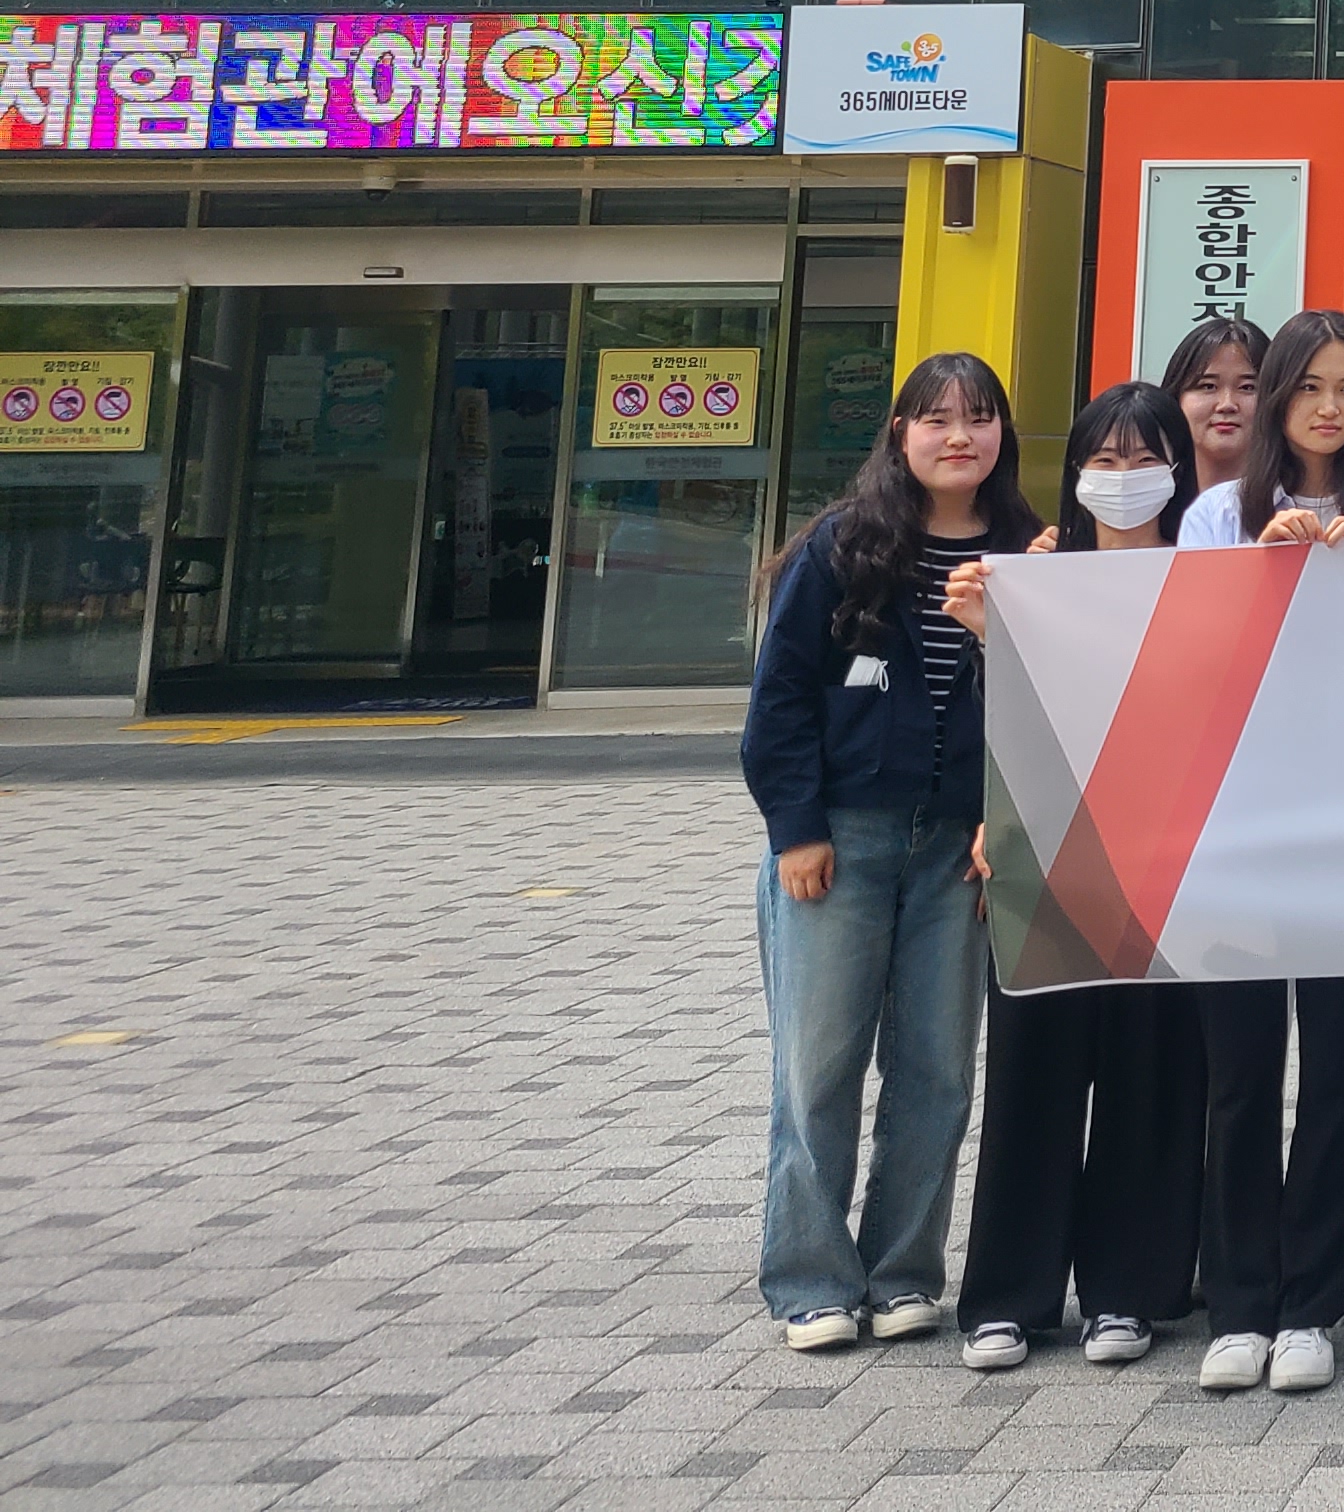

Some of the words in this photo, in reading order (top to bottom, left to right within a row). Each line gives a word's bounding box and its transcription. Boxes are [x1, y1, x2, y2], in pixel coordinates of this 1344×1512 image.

[866, 51, 912, 73] SAFE
[890, 63, 941, 84] TOWN
[839, 89, 968, 112] 365세이프타운
[651, 356, 707, 369] 잠깐만요!!
